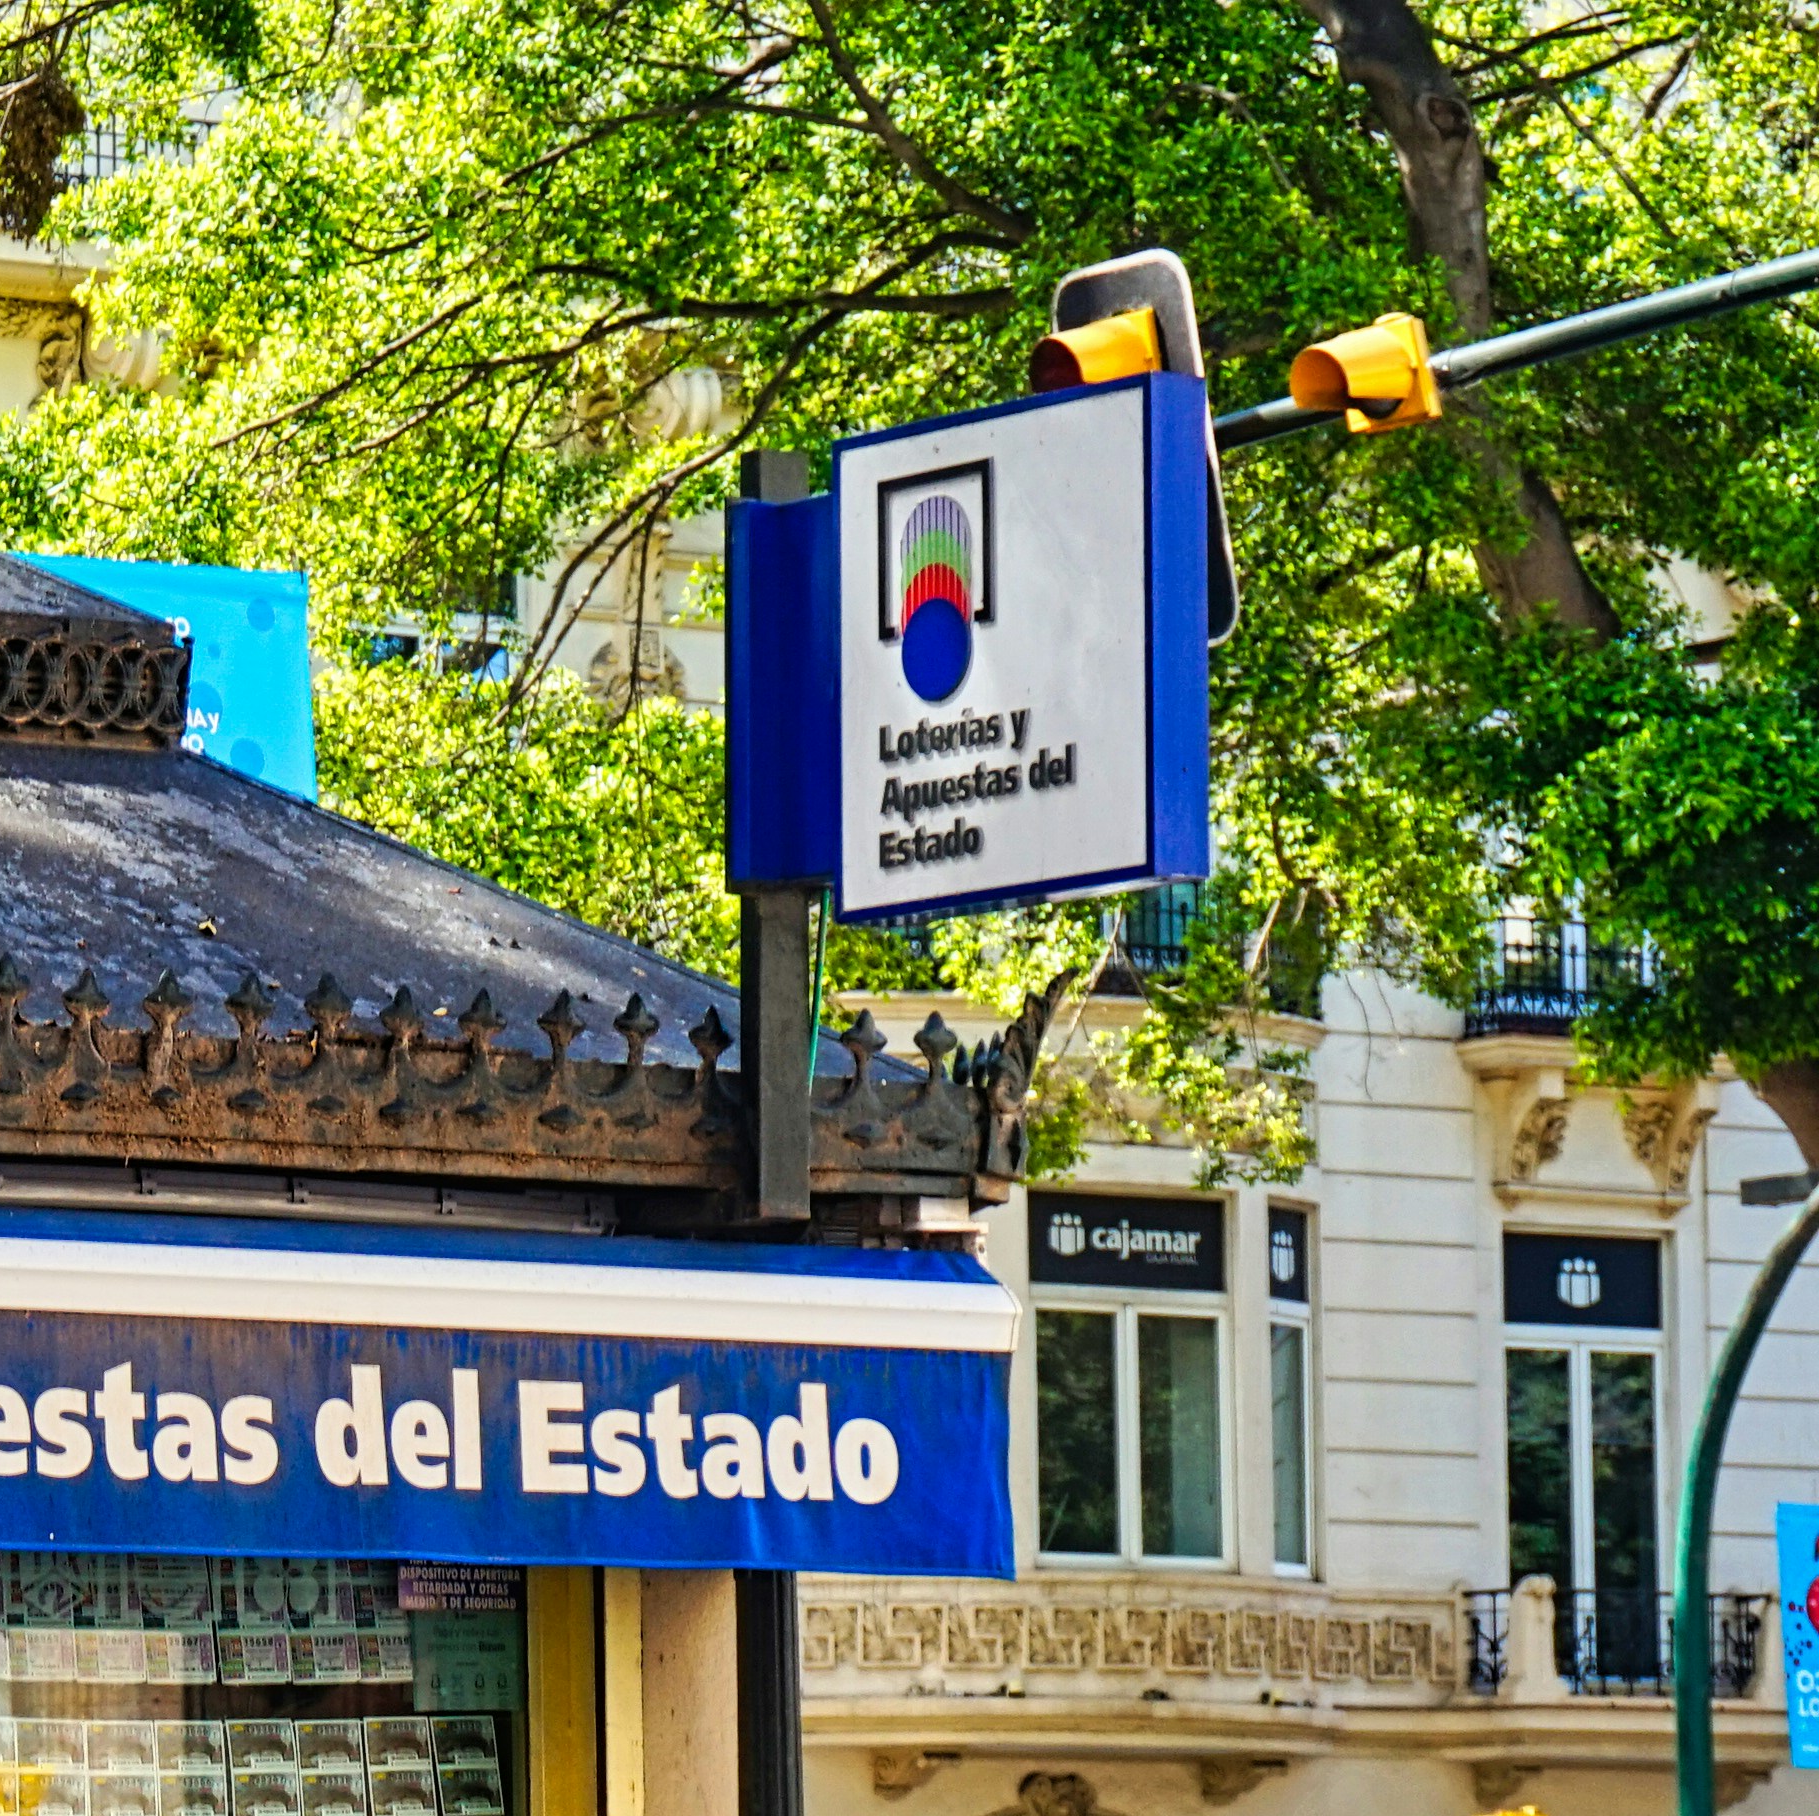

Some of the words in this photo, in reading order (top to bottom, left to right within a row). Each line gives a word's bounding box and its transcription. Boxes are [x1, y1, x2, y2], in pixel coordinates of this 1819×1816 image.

[877, 708, 1001, 767] Loterías
[1011, 706, 1032, 748] y
[881, 766, 1021, 823] Apuestas
[1028, 742, 1078, 790] del
[877, 819, 984, 871] Estado
[1089, 1218, 1202, 1261] cajamar
[315, 1362, 482, 1493] del
[520, 1378, 900, 1506] Estado
[400, 1566, 459, 1581] DISPOSITIVO
[460, 1568, 472, 1580] DE
[473, 1568, 521, 1582] APERTURA
[413, 1581, 467, 1595] RETARDADA
[470, 1582, 476, 1594] Y
[478, 1583, 509, 1596] OTRAS
[450, 1597, 462, 1609] DE
[464, 1596, 517, 1610] SEGURIDAD
